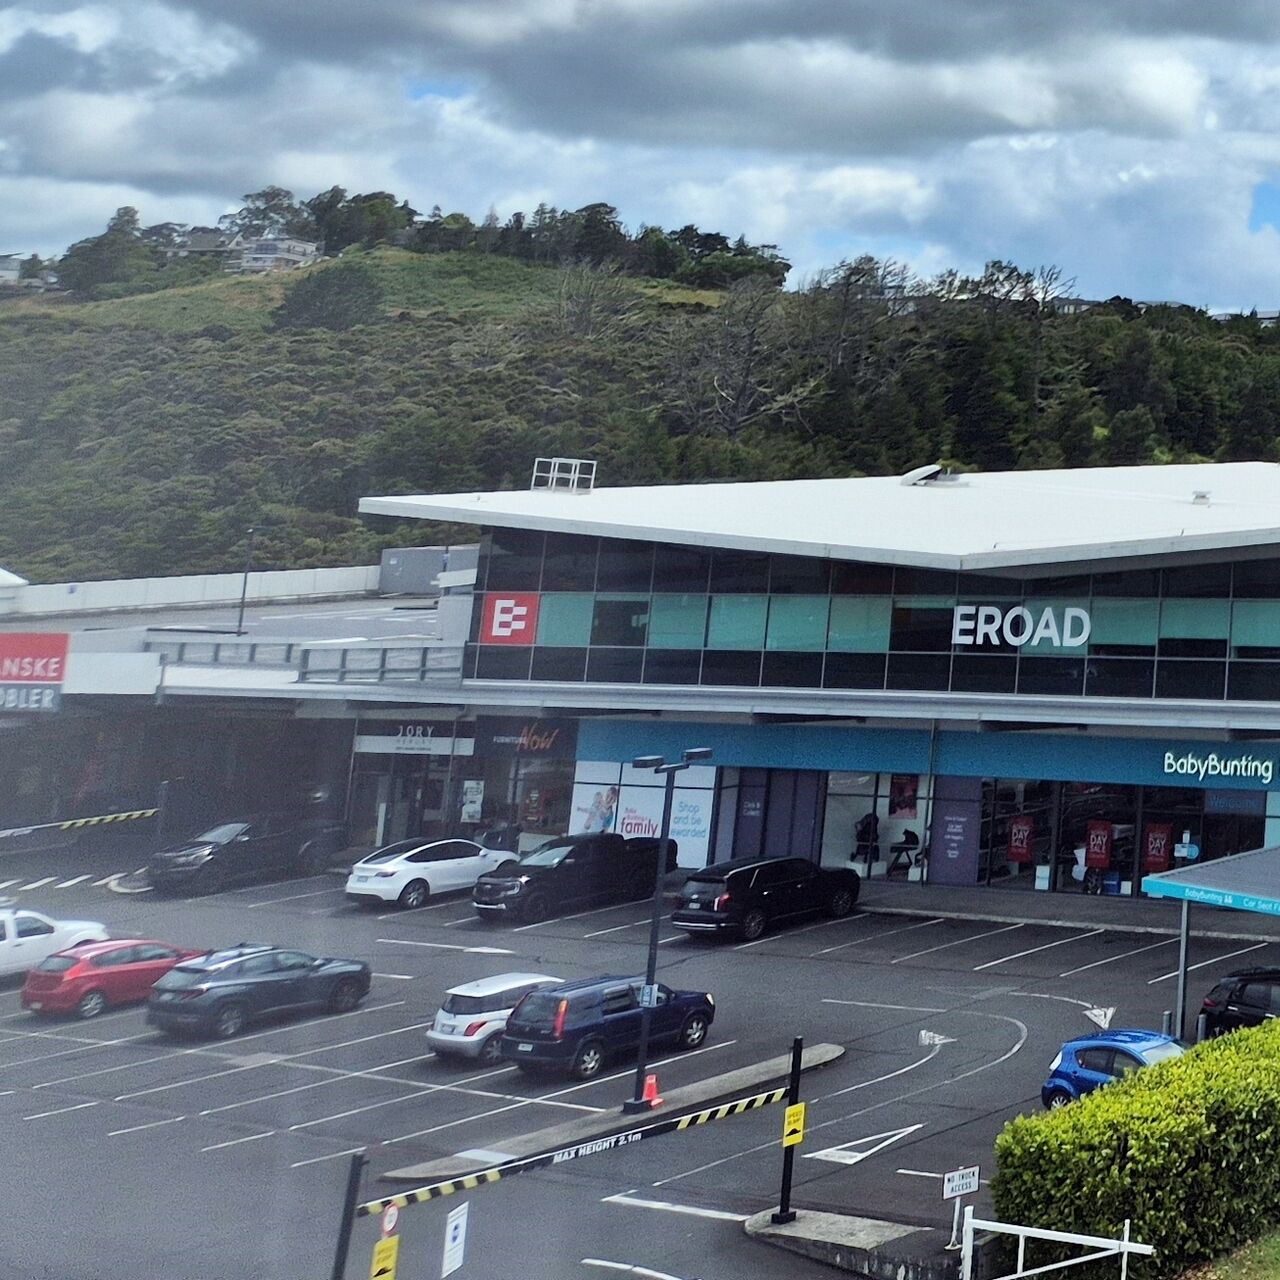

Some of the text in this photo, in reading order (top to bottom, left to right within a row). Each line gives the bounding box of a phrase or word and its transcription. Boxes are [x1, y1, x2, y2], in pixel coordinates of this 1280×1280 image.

[951, 605, 1091, 647] EROAD
[0, 656, 60, 677] NSKE
[397, 725, 434, 738] JORY
[1164, 752, 1273, 784] BabyBunting
[678, 801, 701, 815] Shop
[620, 817, 659, 838] family
[670, 827, 706, 838] ewarded
[1012, 829, 1030, 840] DAY
[1090, 835, 1108, 846] DAY
[1149, 838, 1167, 849] DAY
[1185, 888, 1223, 904] BabyBunting
[1243, 898, 1255, 908] Car
[1257, 900, 1273, 912] Seat
[553, 1132, 642, 1164] MAX HEIGHT 2.1m
[951, 1181, 972, 1193] ACCESS
